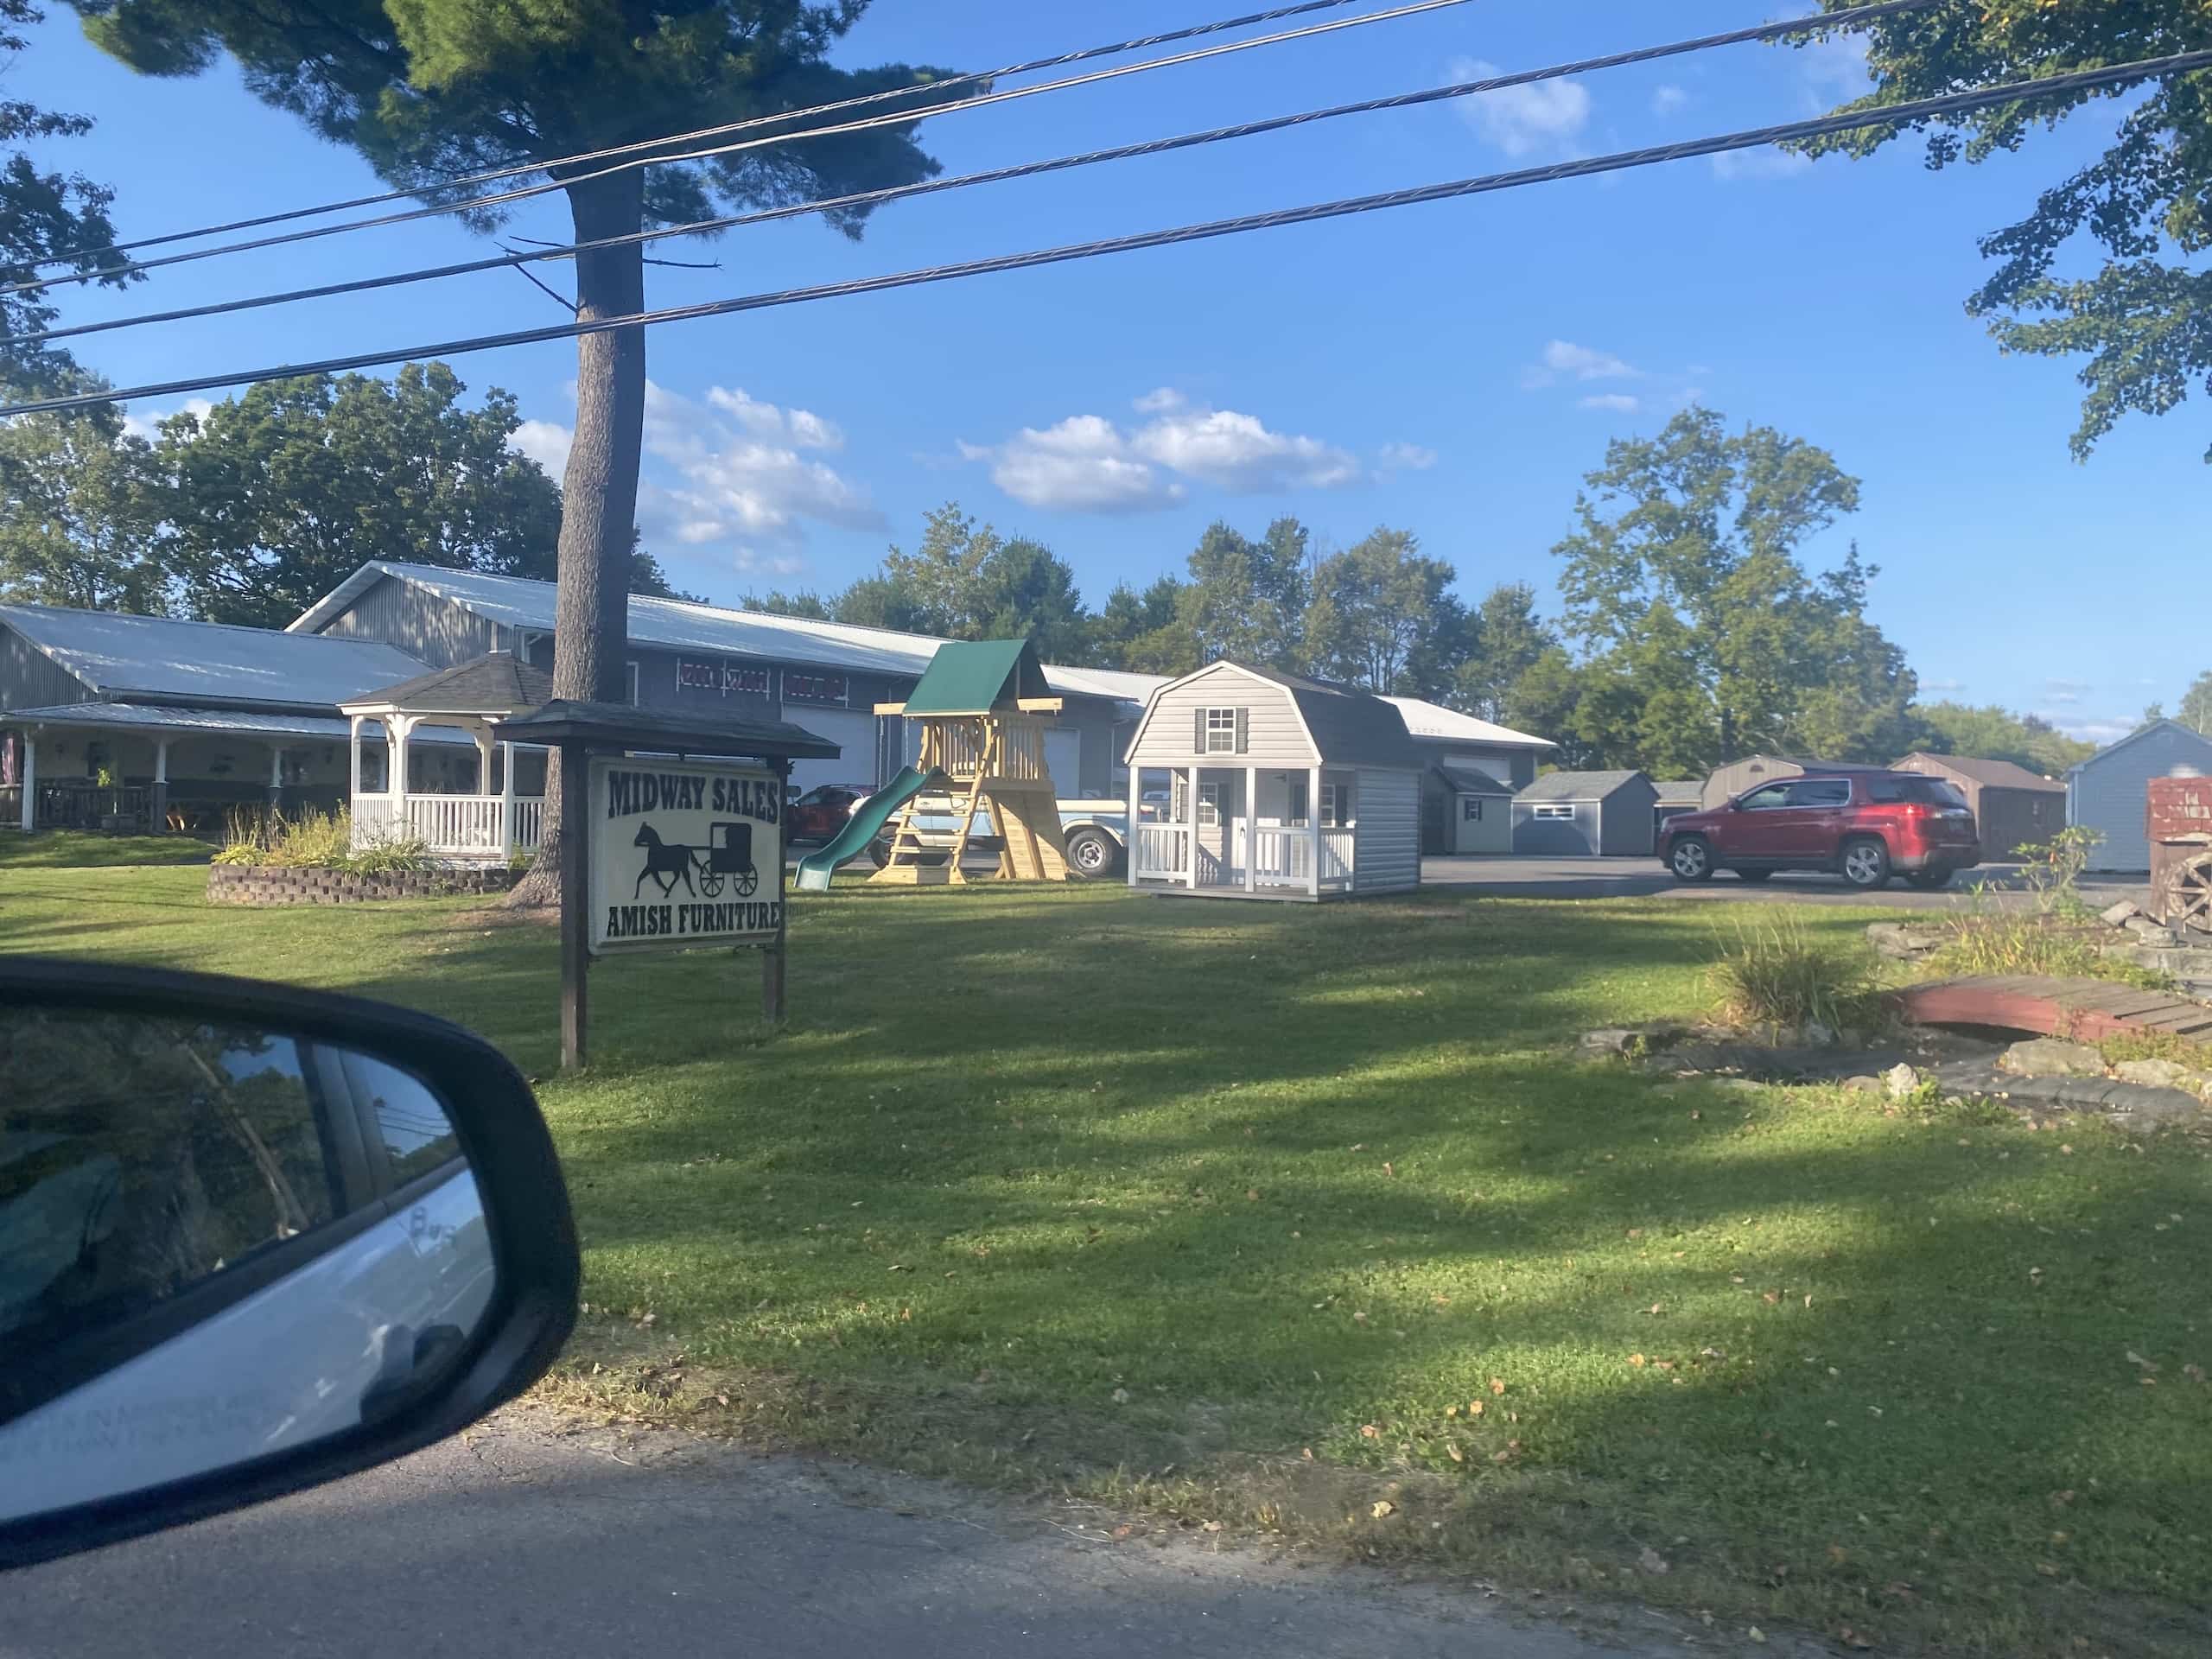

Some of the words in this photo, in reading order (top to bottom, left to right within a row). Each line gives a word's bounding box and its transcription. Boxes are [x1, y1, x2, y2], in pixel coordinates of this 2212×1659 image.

[608, 771, 705, 819] MIDWAY
[712, 779, 779, 823] SALES
[607, 906, 671, 936] AMISH
[678, 902, 779, 933] FURNITURE
